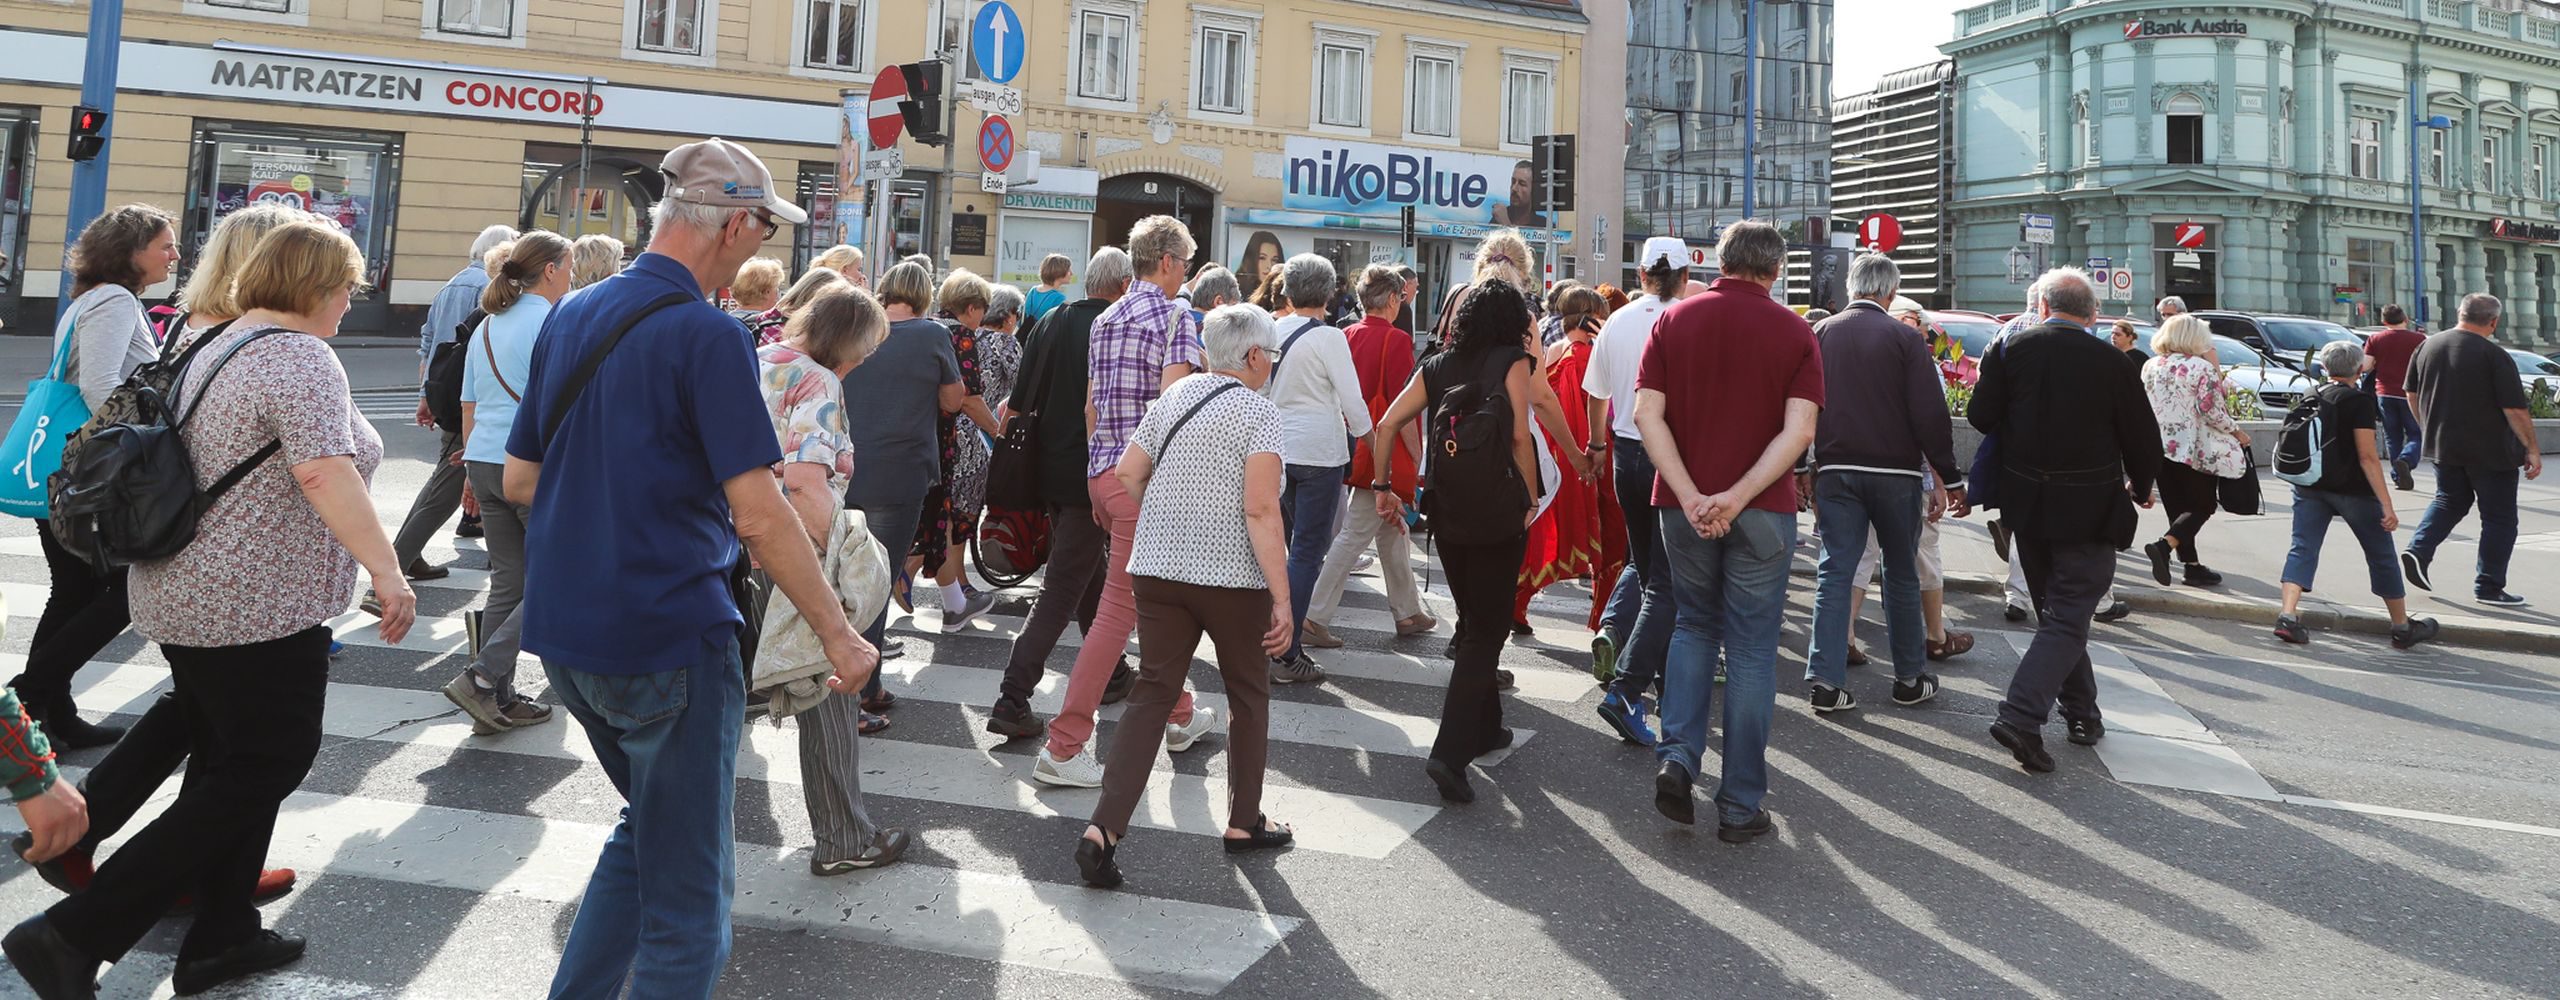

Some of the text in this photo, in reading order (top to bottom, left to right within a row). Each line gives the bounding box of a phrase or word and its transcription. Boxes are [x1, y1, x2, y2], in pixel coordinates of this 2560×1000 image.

[2143, 18, 2247, 35] Bank Austria
[211, 59, 604, 116] MATRATZEN CONCORD
[251, 161, 314, 173] PERSONAL-
[251, 170, 282, 180] KAUF
[1289, 149, 1489, 209] nikoBlue
[986, 176, 1003, 189] Ende
[1005, 194, 1096, 211] DR. VALENTIN
[1437, 224, 1451, 234] Die
[1002, 240, 1034, 261] MF
[1459, 251, 1476, 260] niko
[2114, 290, 2131, 299] Zone
